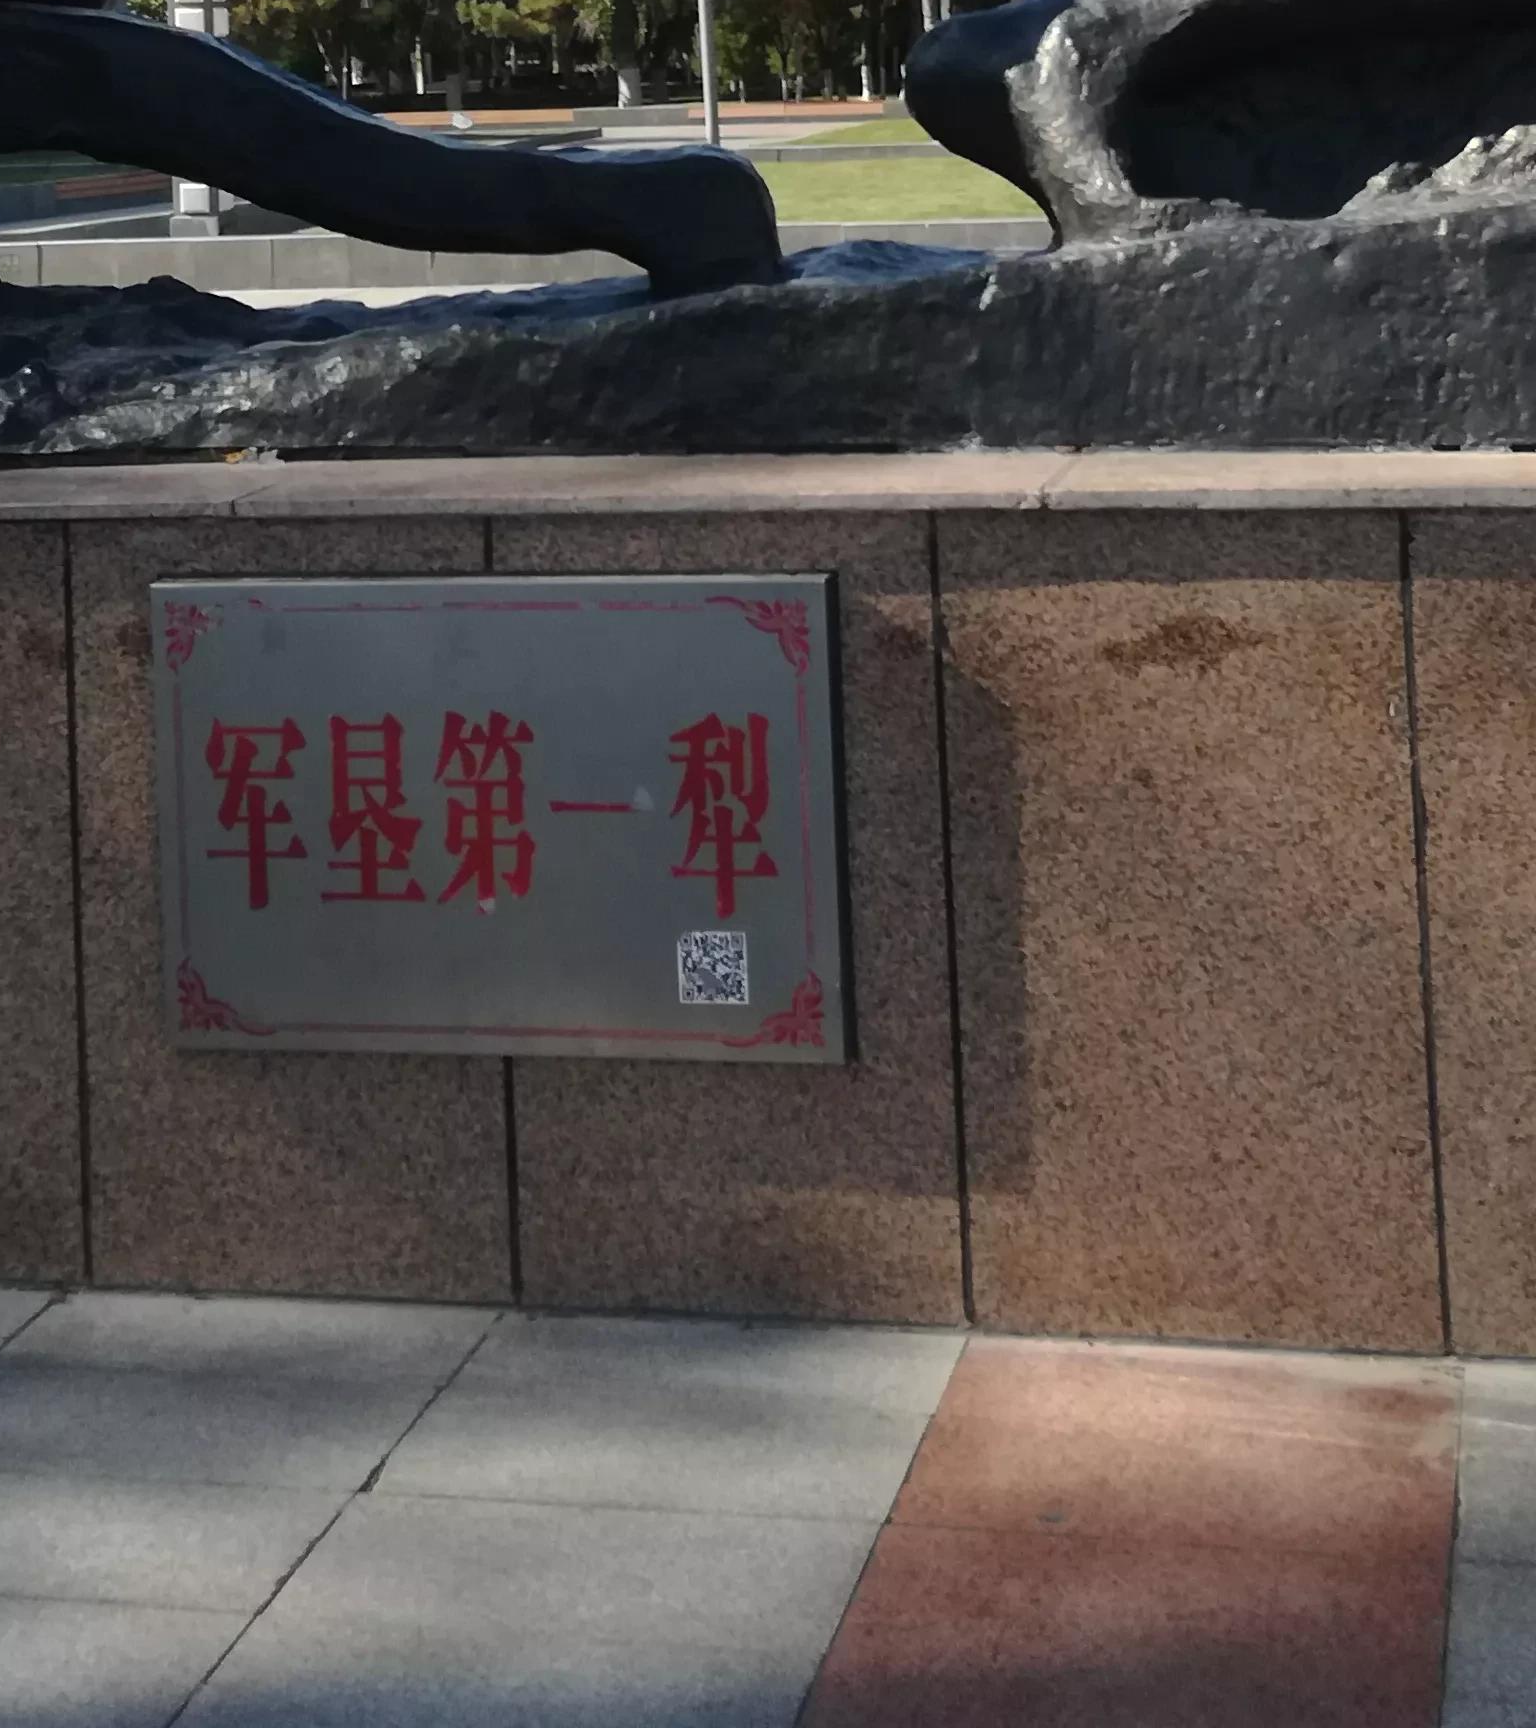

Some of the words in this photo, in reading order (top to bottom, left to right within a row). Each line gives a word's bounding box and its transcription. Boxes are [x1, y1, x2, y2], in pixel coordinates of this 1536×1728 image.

[205, 710, 779, 919] 军垦第一犁
